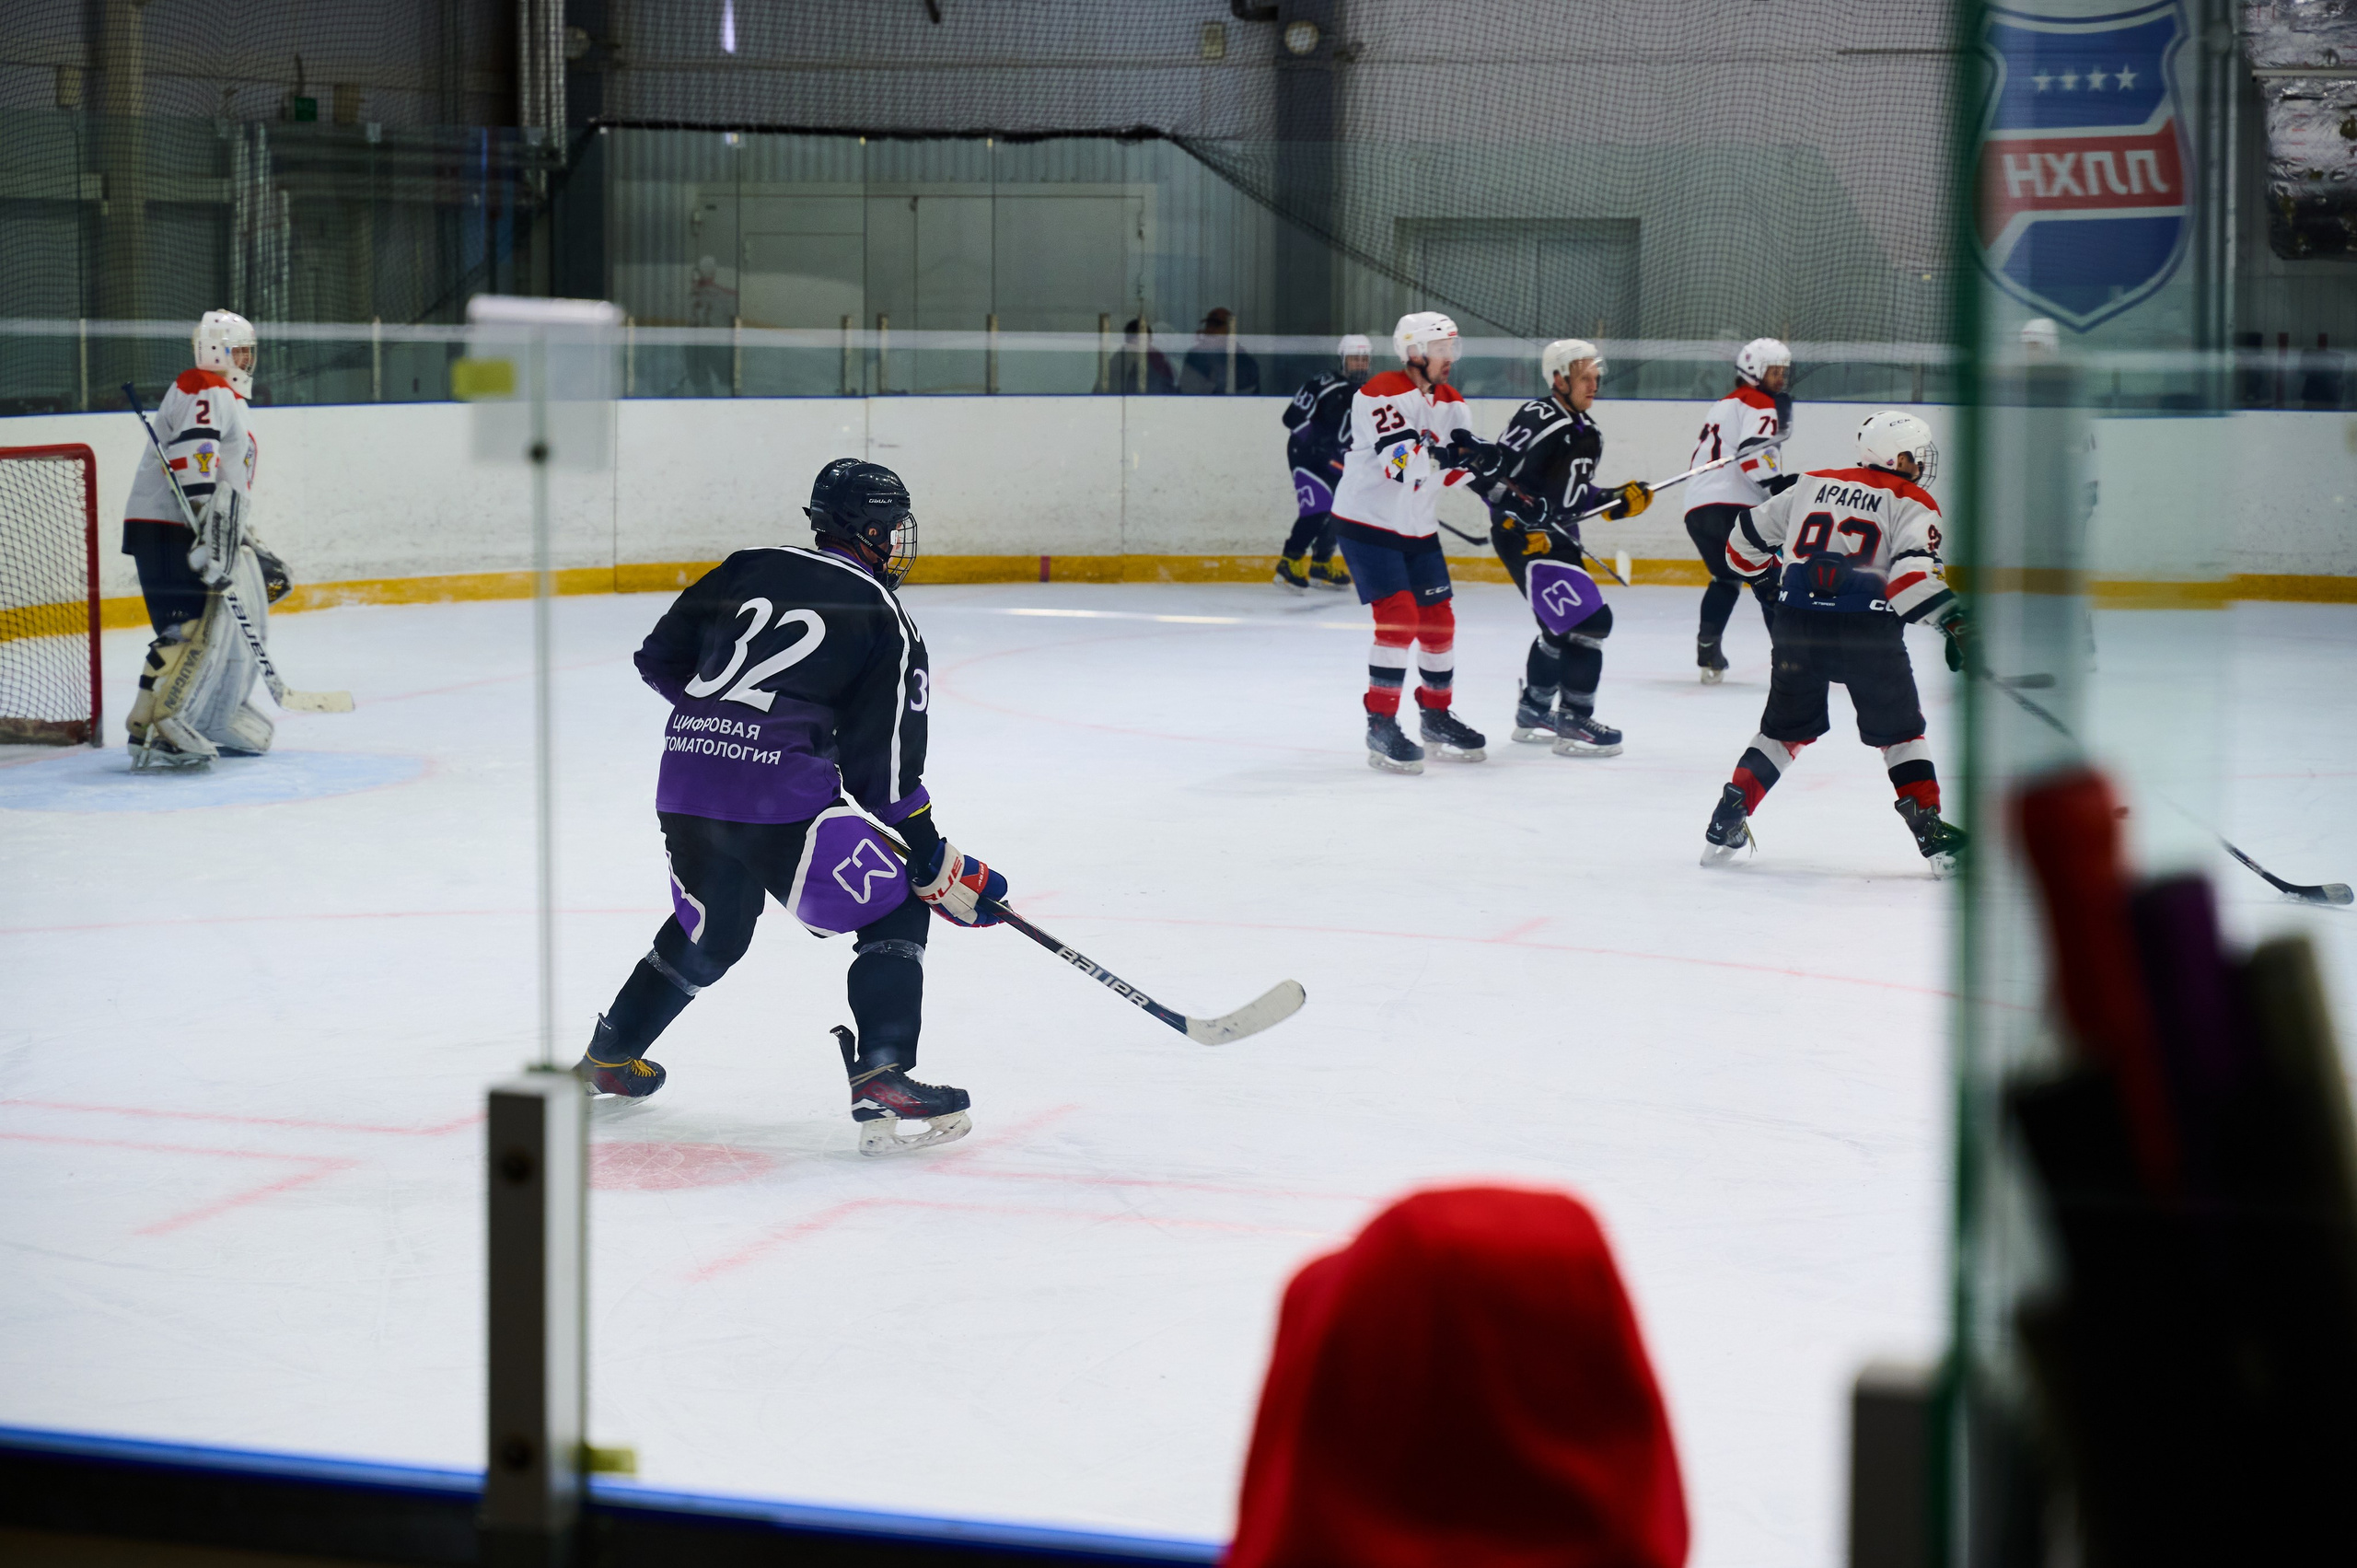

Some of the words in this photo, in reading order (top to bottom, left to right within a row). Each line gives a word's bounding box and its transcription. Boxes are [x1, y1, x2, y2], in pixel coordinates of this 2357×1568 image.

[196, 399, 211, 424] 2
[1372, 403, 1406, 435] 23
[1757, 415, 1779, 436] 71
[1814, 483, 1883, 513] APARIN
[683, 597, 827, 714] 32
[164, 648, 203, 710] VAUGHN
[672, 714, 761, 741] ЦИФРОВАЯ
[664, 735, 782, 765] ТОМАТОЛОГИЯ
[918, 855, 963, 901] RUE
[1056, 947, 1150, 1009] BAUER
